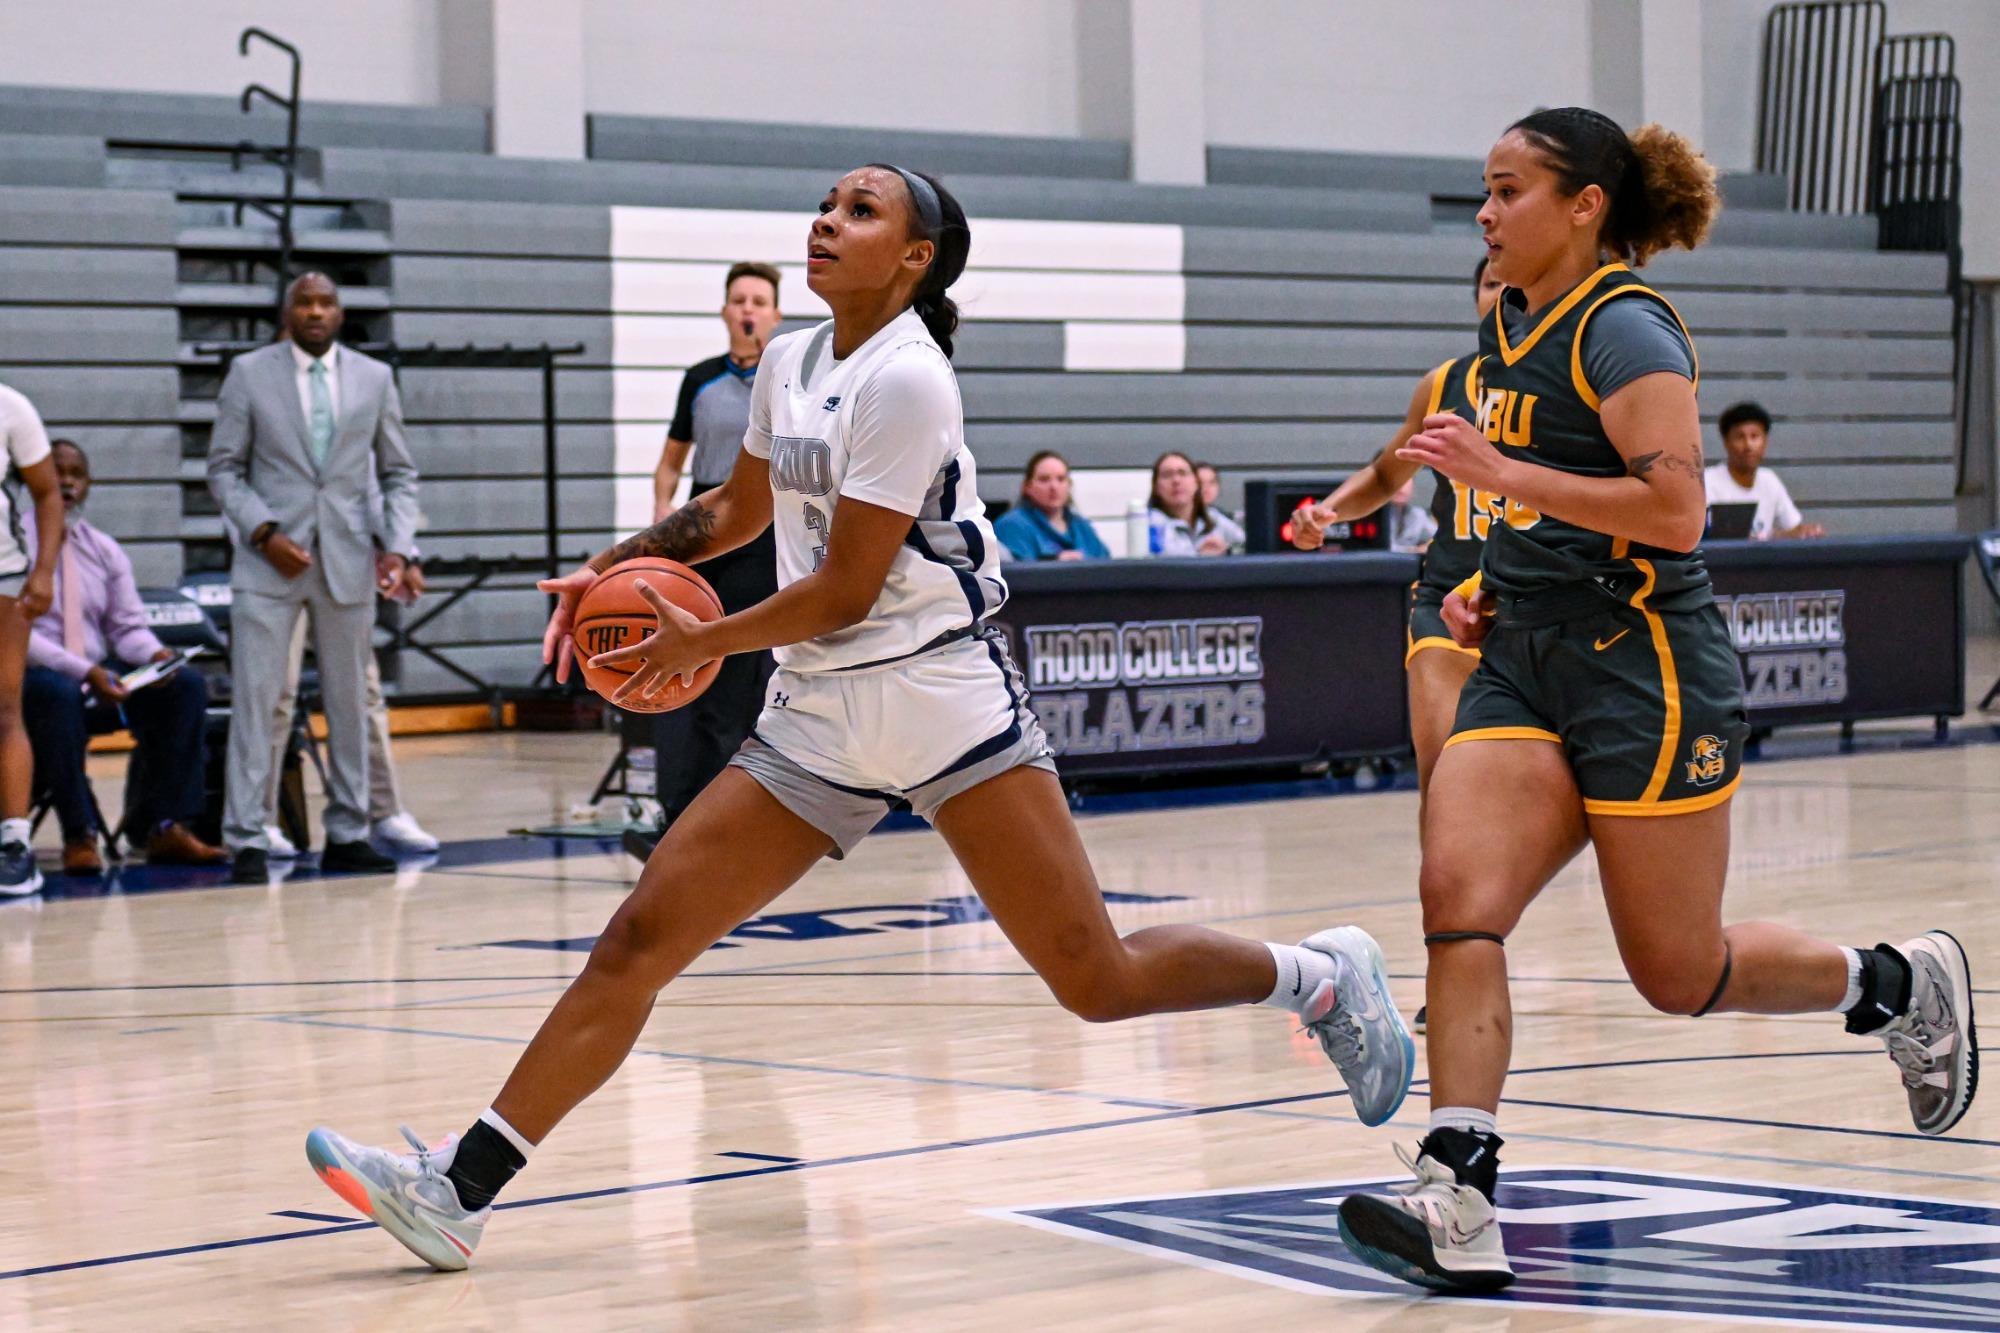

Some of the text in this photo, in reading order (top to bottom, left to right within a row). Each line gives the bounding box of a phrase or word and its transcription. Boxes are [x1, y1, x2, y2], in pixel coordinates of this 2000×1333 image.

[586, 625, 628, 653] THE
[1735, 595, 1843, 648] COLLEGE
[1029, 620, 1261, 686] HOOD COLLEGE
[1032, 683, 1265, 756] BLAZERS
